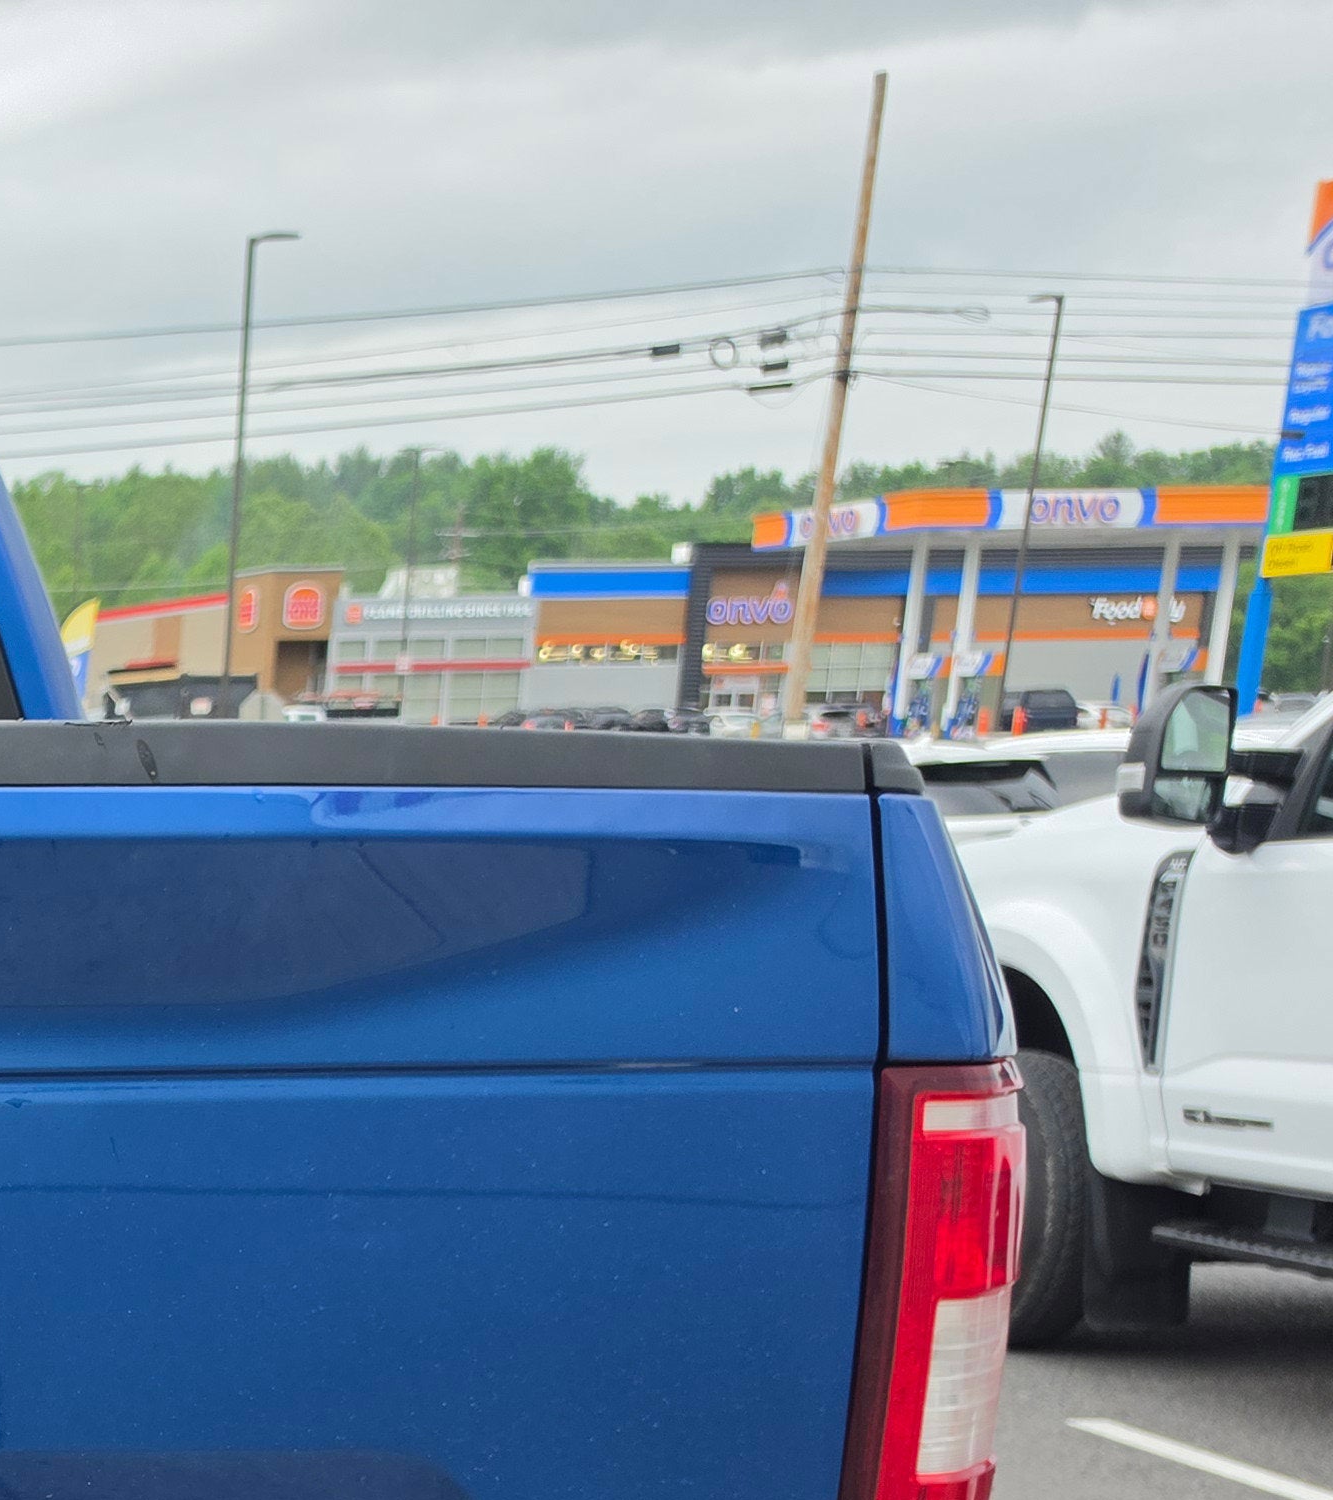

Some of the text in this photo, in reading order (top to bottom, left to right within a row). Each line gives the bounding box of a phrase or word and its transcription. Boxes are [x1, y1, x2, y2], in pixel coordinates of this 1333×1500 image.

[799, 508, 859, 538] ovo
[1030, 494, 1122, 524] onvo
[706, 596, 793, 626] onvo
[1090, 596, 1142, 620] Food
